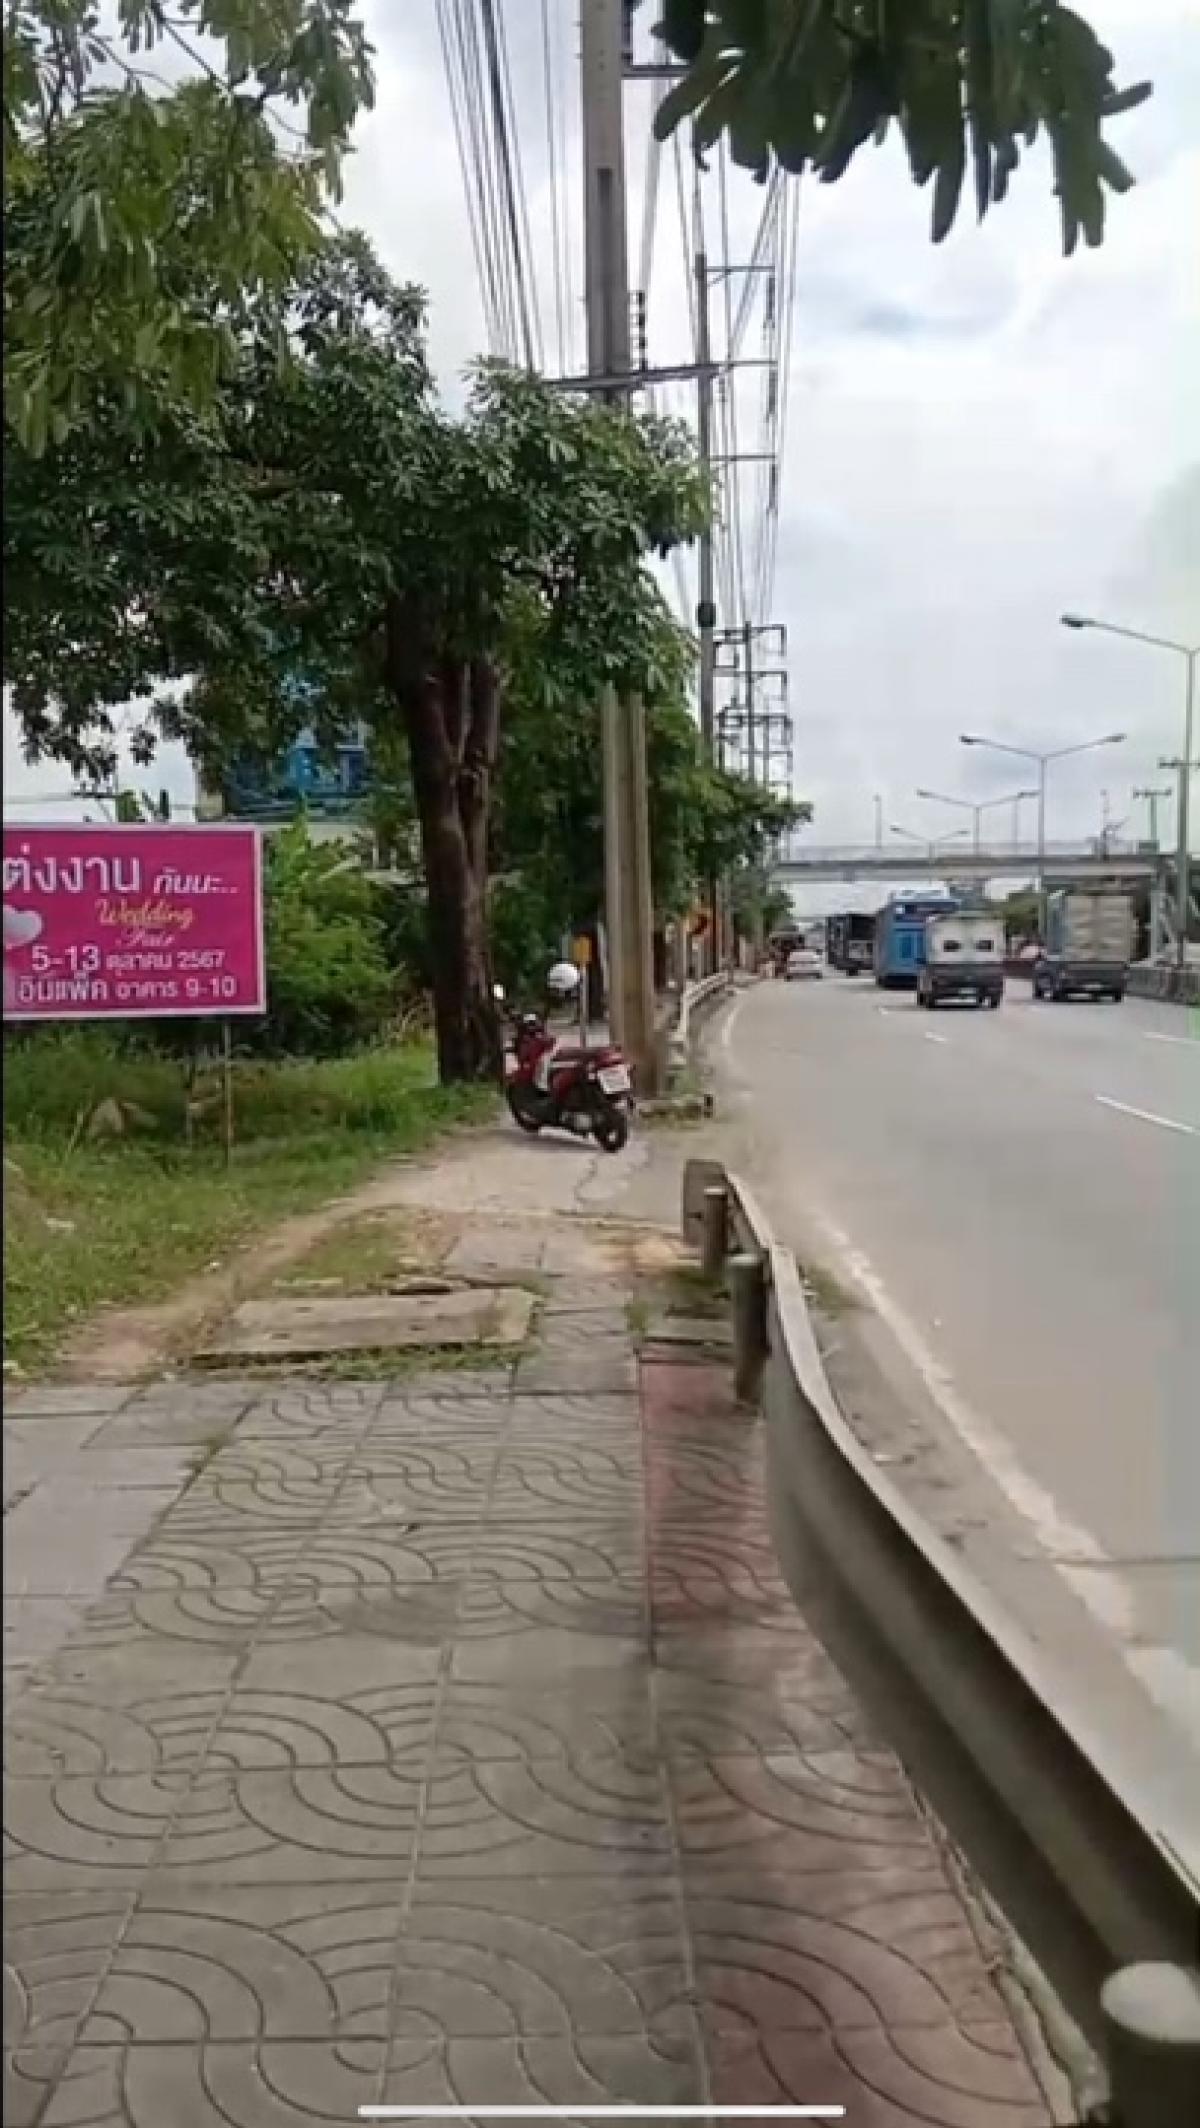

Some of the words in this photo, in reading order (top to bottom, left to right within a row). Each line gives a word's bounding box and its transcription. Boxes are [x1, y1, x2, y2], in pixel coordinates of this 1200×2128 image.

[32, 945, 99, 971] 5-13
[176, 949, 226, 970] 2567
[185, 976, 237, 998] 9-10
